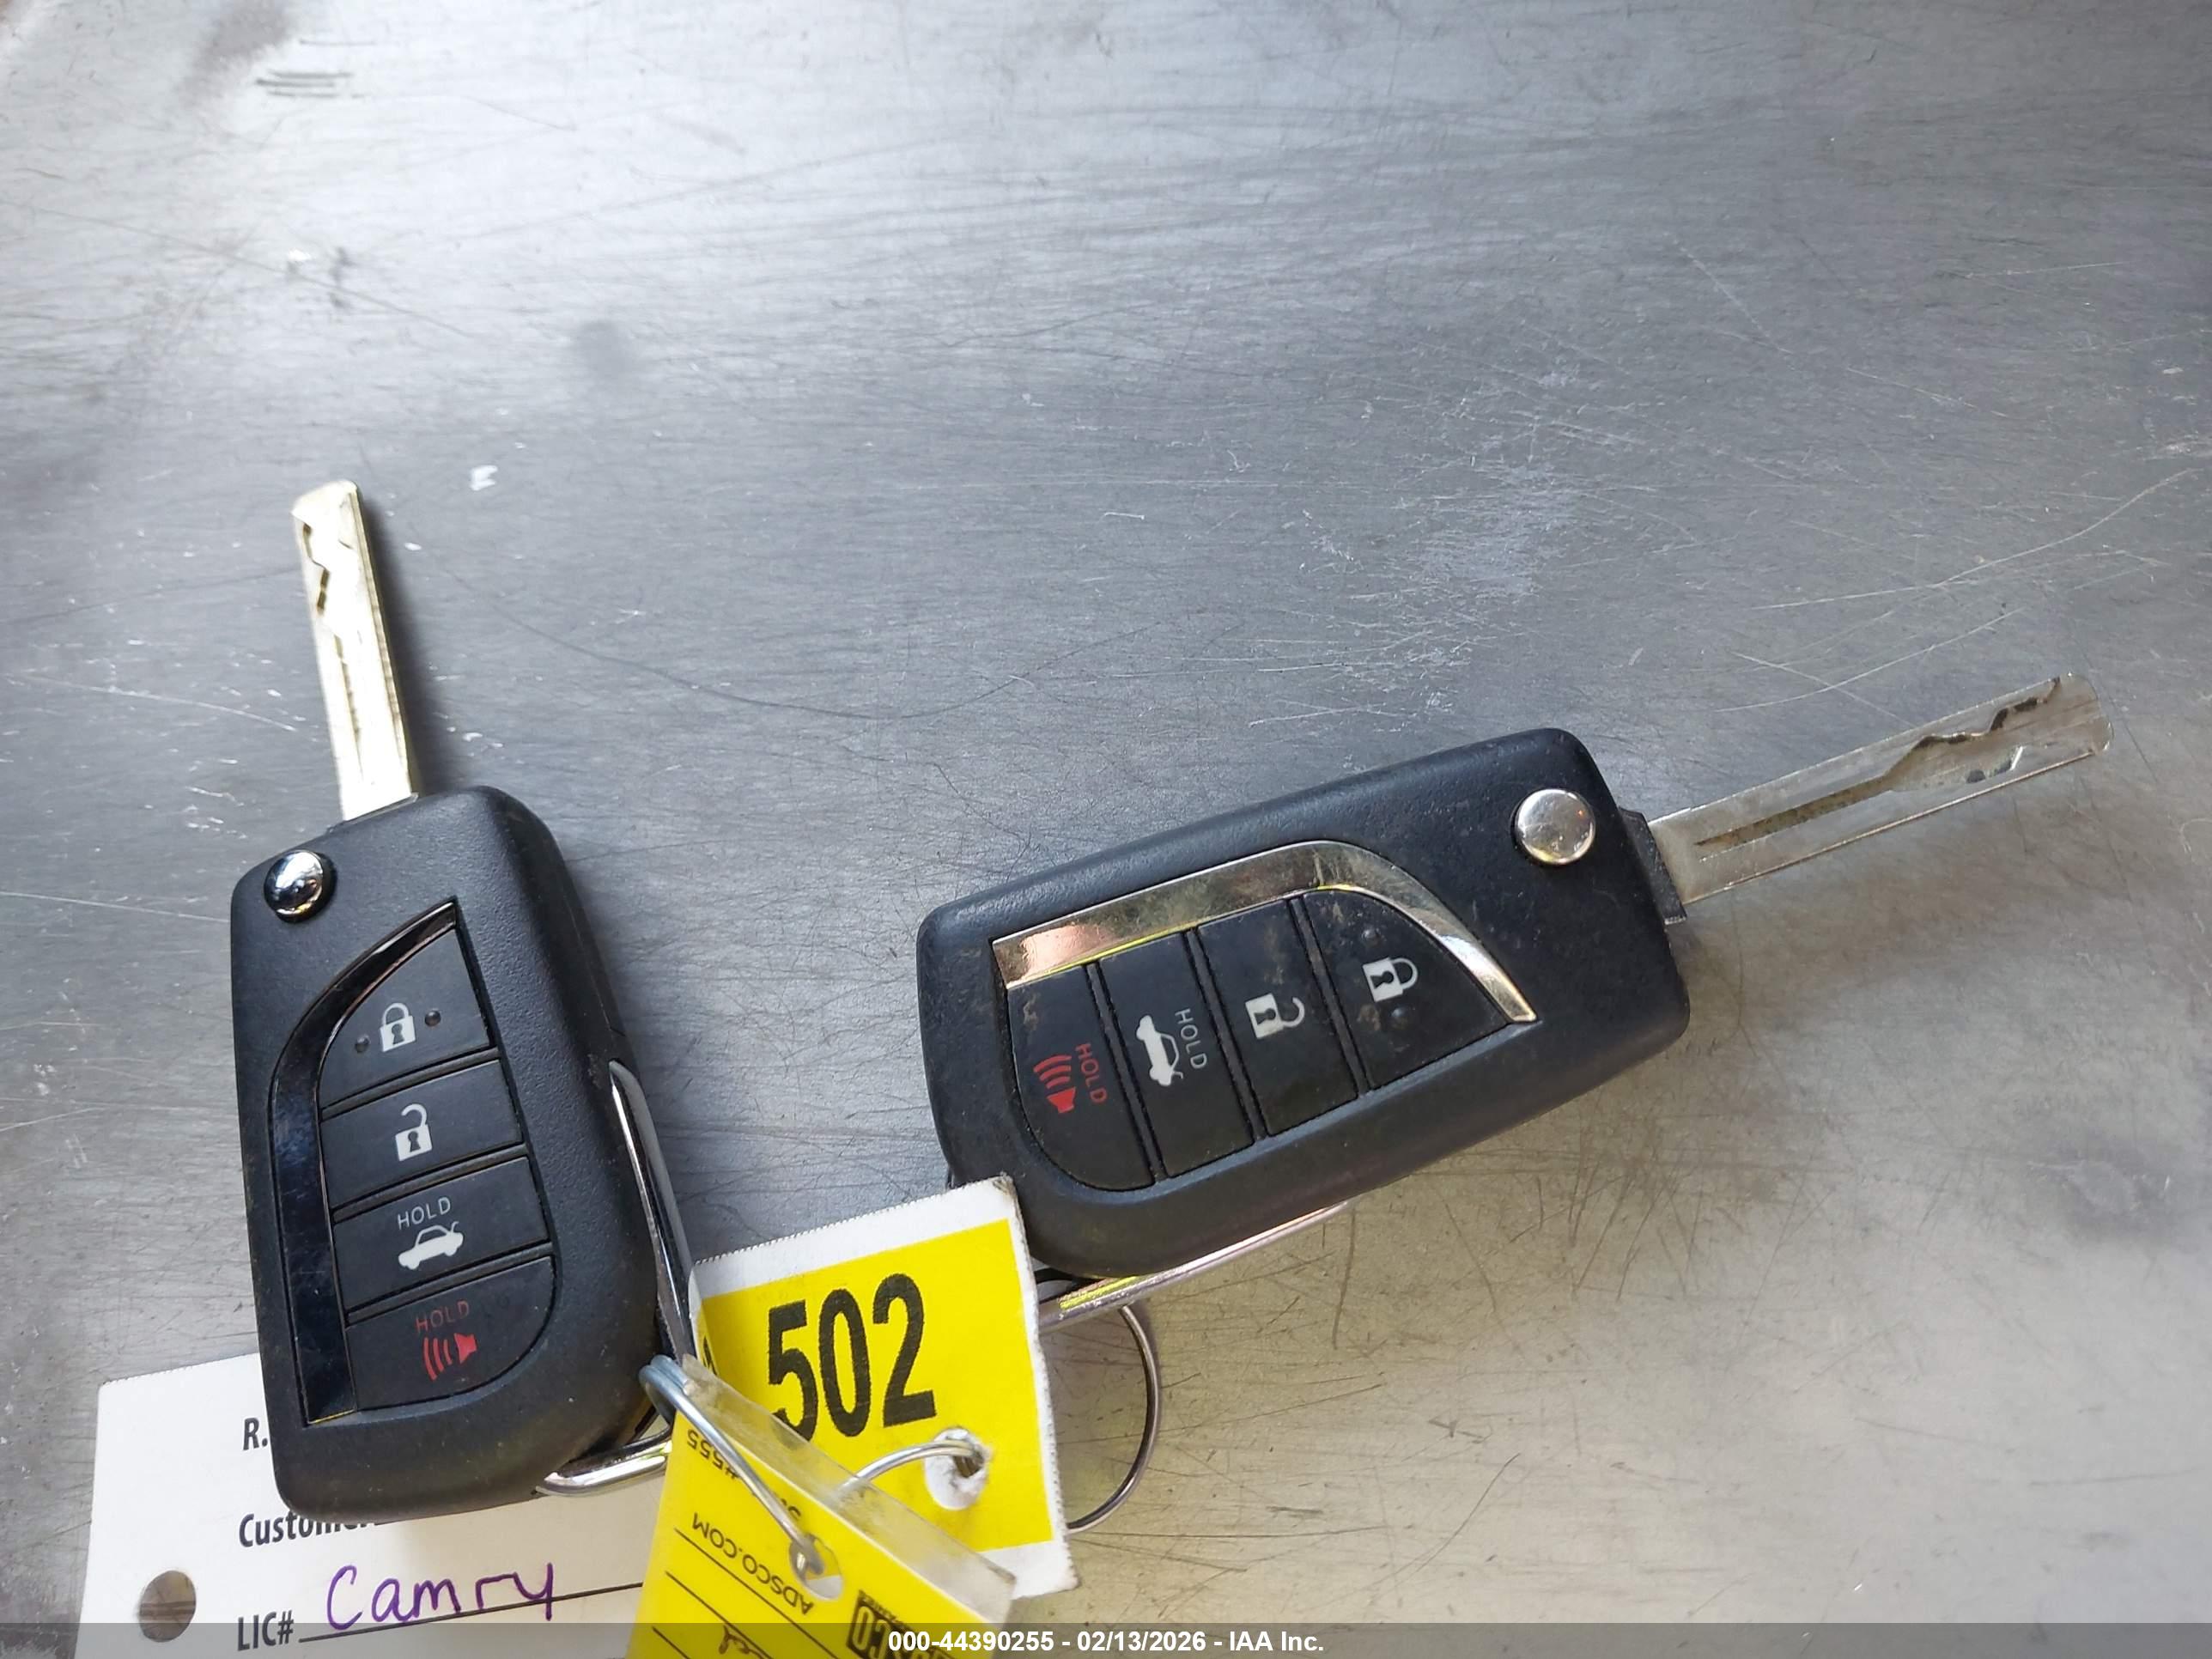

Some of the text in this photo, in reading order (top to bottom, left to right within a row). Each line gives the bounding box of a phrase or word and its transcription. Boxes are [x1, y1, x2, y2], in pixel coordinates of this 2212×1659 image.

[1176, 1009, 1207, 1069] HOLD
[1077, 1043, 1107, 1103] HOLD
[397, 1196, 451, 1230] HOLD
[415, 1299, 470, 1332] HOLD
[767, 1273, 937, 1444] 502
[243, 1417, 268, 1451] R.
[238, 1512, 368, 1547] Custo
[691, 1511, 814, 1615] ADSCO.COM
[326, 1562, 554, 1631] Camry
[237, 1609, 295, 1651] LIC#
